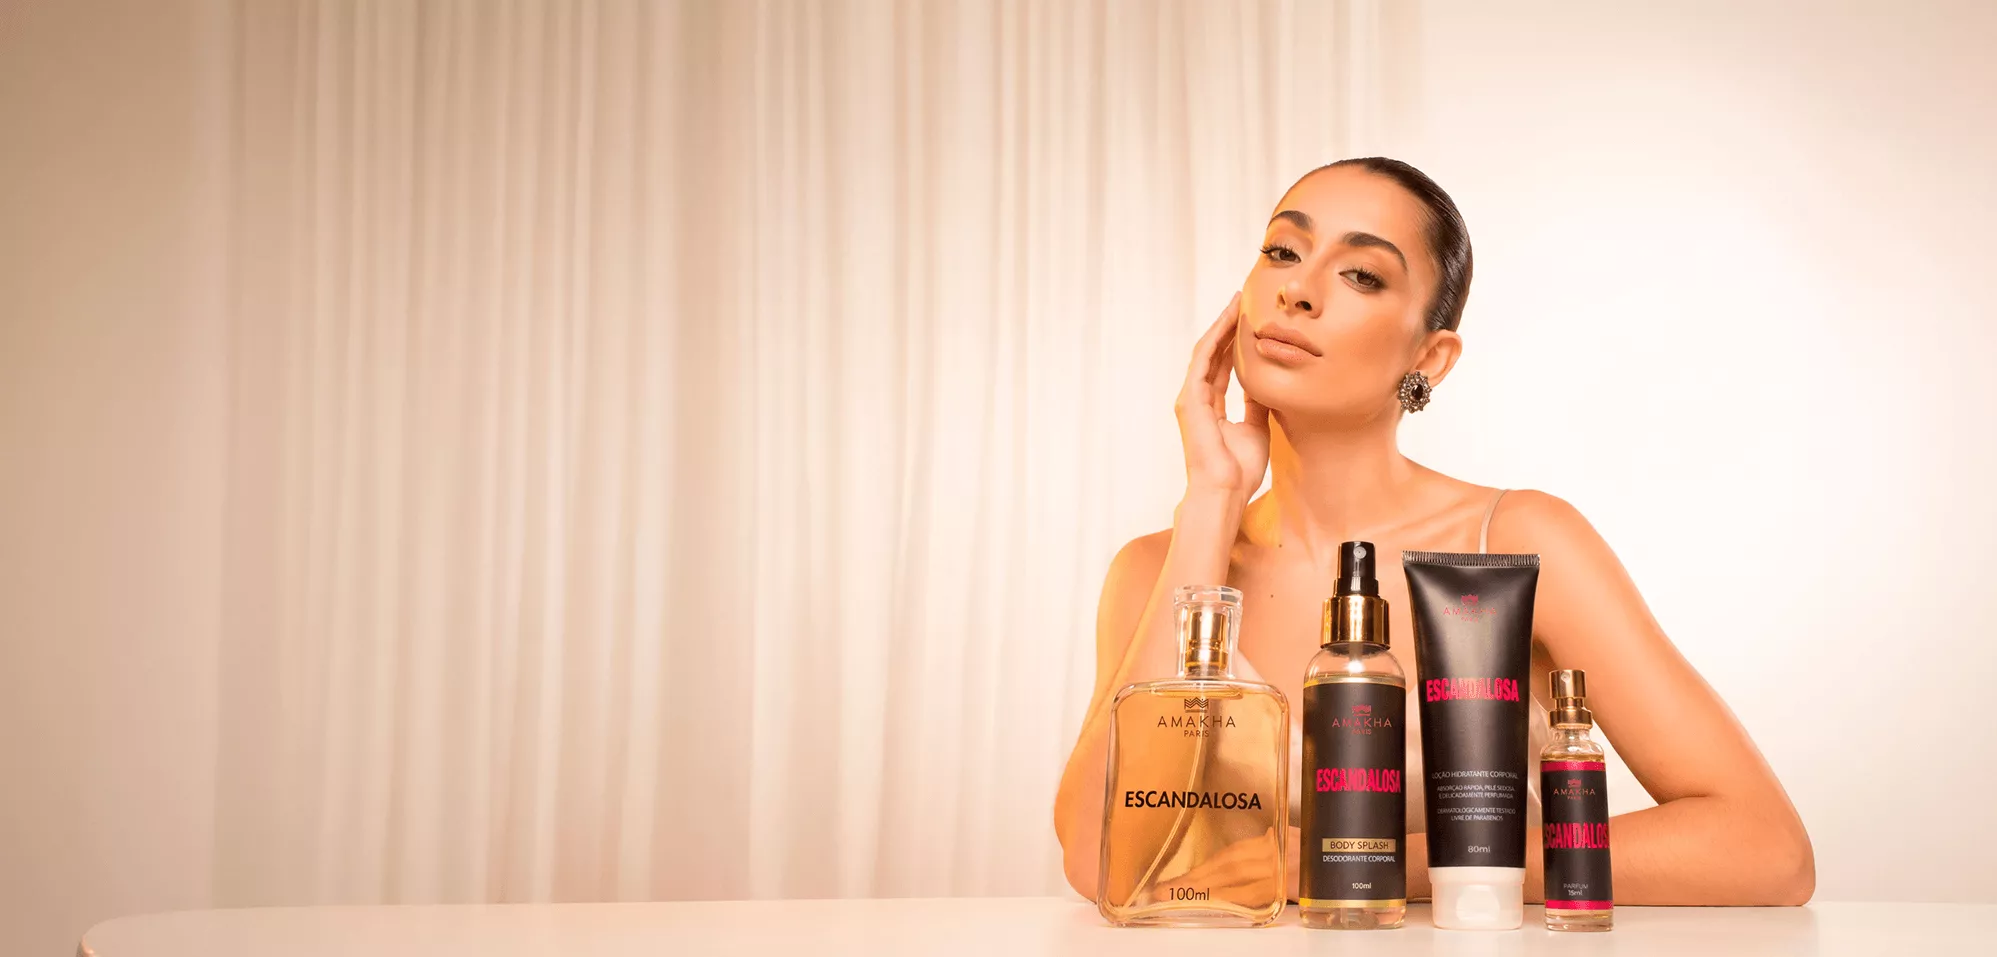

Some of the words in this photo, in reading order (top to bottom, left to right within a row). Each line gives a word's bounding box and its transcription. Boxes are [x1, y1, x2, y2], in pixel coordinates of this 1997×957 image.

[1426, 677, 1520, 702] ESCANDALOSA
[1157, 716, 1236, 728] AMAKHA
[1332, 718, 1392, 728] AMAKHA
[1451, 770, 1489, 778] HIDRATANTE
[1489, 770, 1519, 779] CORPORAL
[1316, 768, 1401, 793] ESCANDALOSA
[1125, 790, 1262, 810] ESCANDALOSA
[1330, 841, 1355, 850] BODY
[1357, 841, 1389, 850] SPLASH
[1467, 845, 1491, 853] 80ml
[1322, 855, 1367, 863] DESODORANTE
[1368, 855, 1396, 863] CORPORAL
[1169, 887, 1210, 900] 100ml
